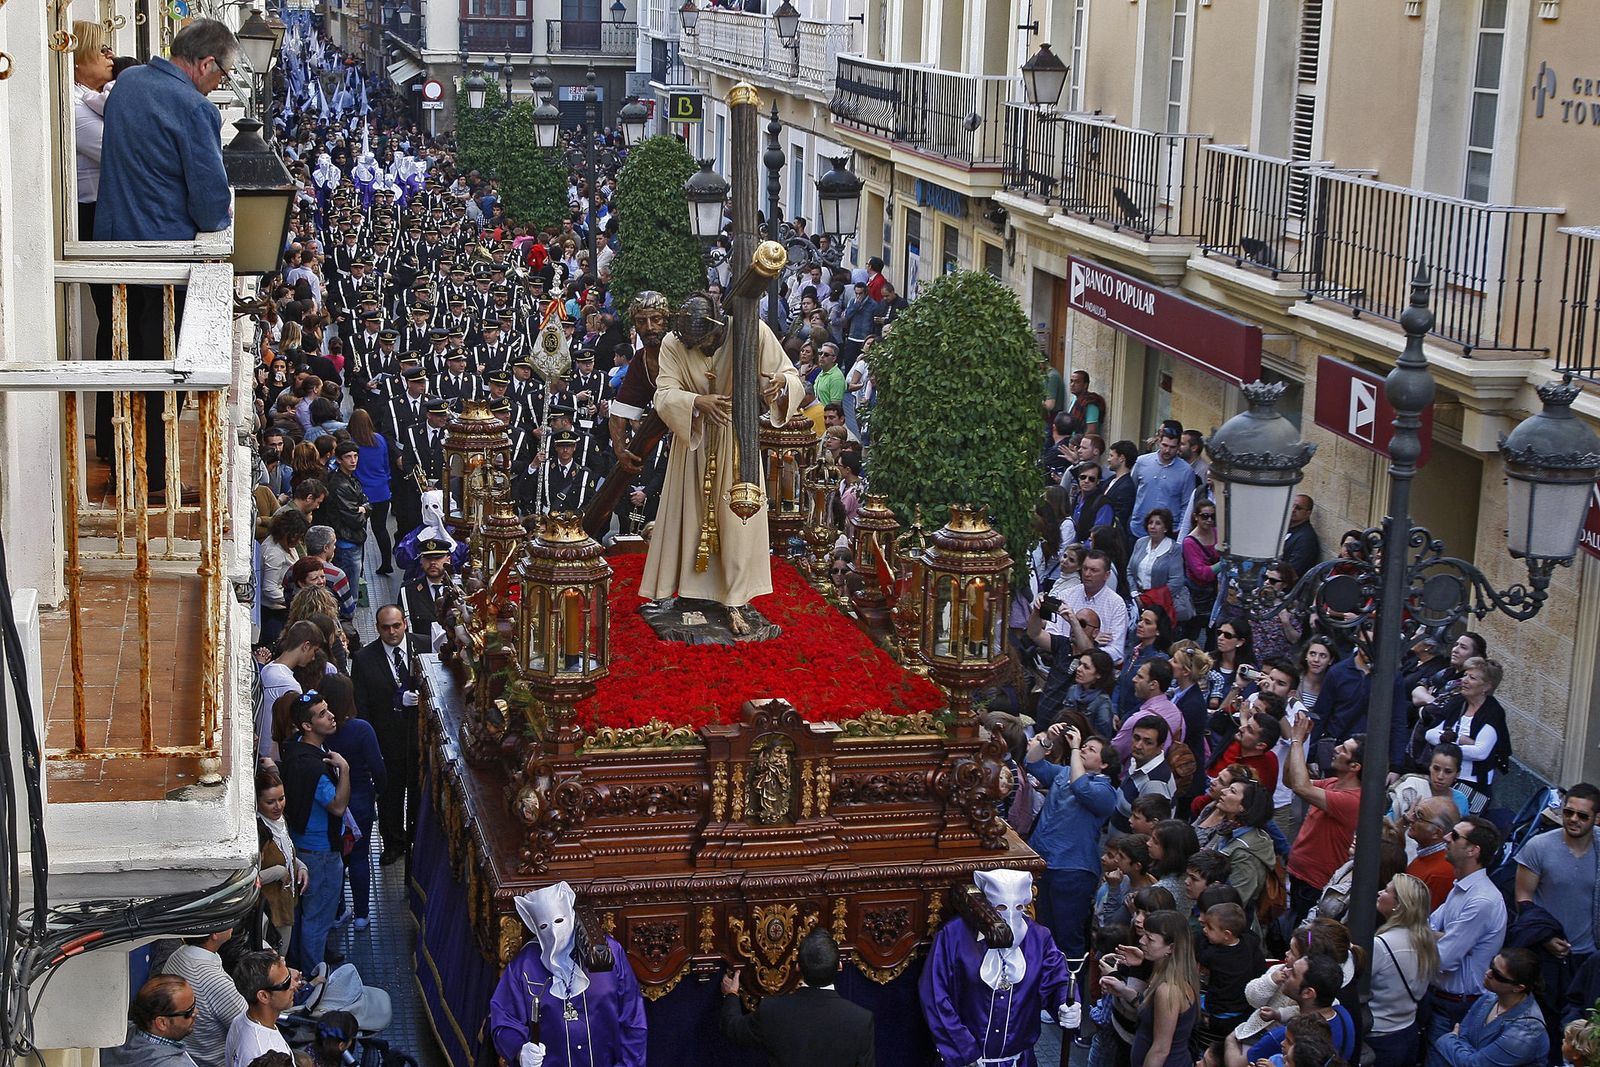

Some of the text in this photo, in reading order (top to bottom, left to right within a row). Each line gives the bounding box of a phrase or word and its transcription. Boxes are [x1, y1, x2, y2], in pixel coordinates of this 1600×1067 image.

[678, 96, 694, 116] B
[1085, 266, 1155, 316] BANCO POPULAR
